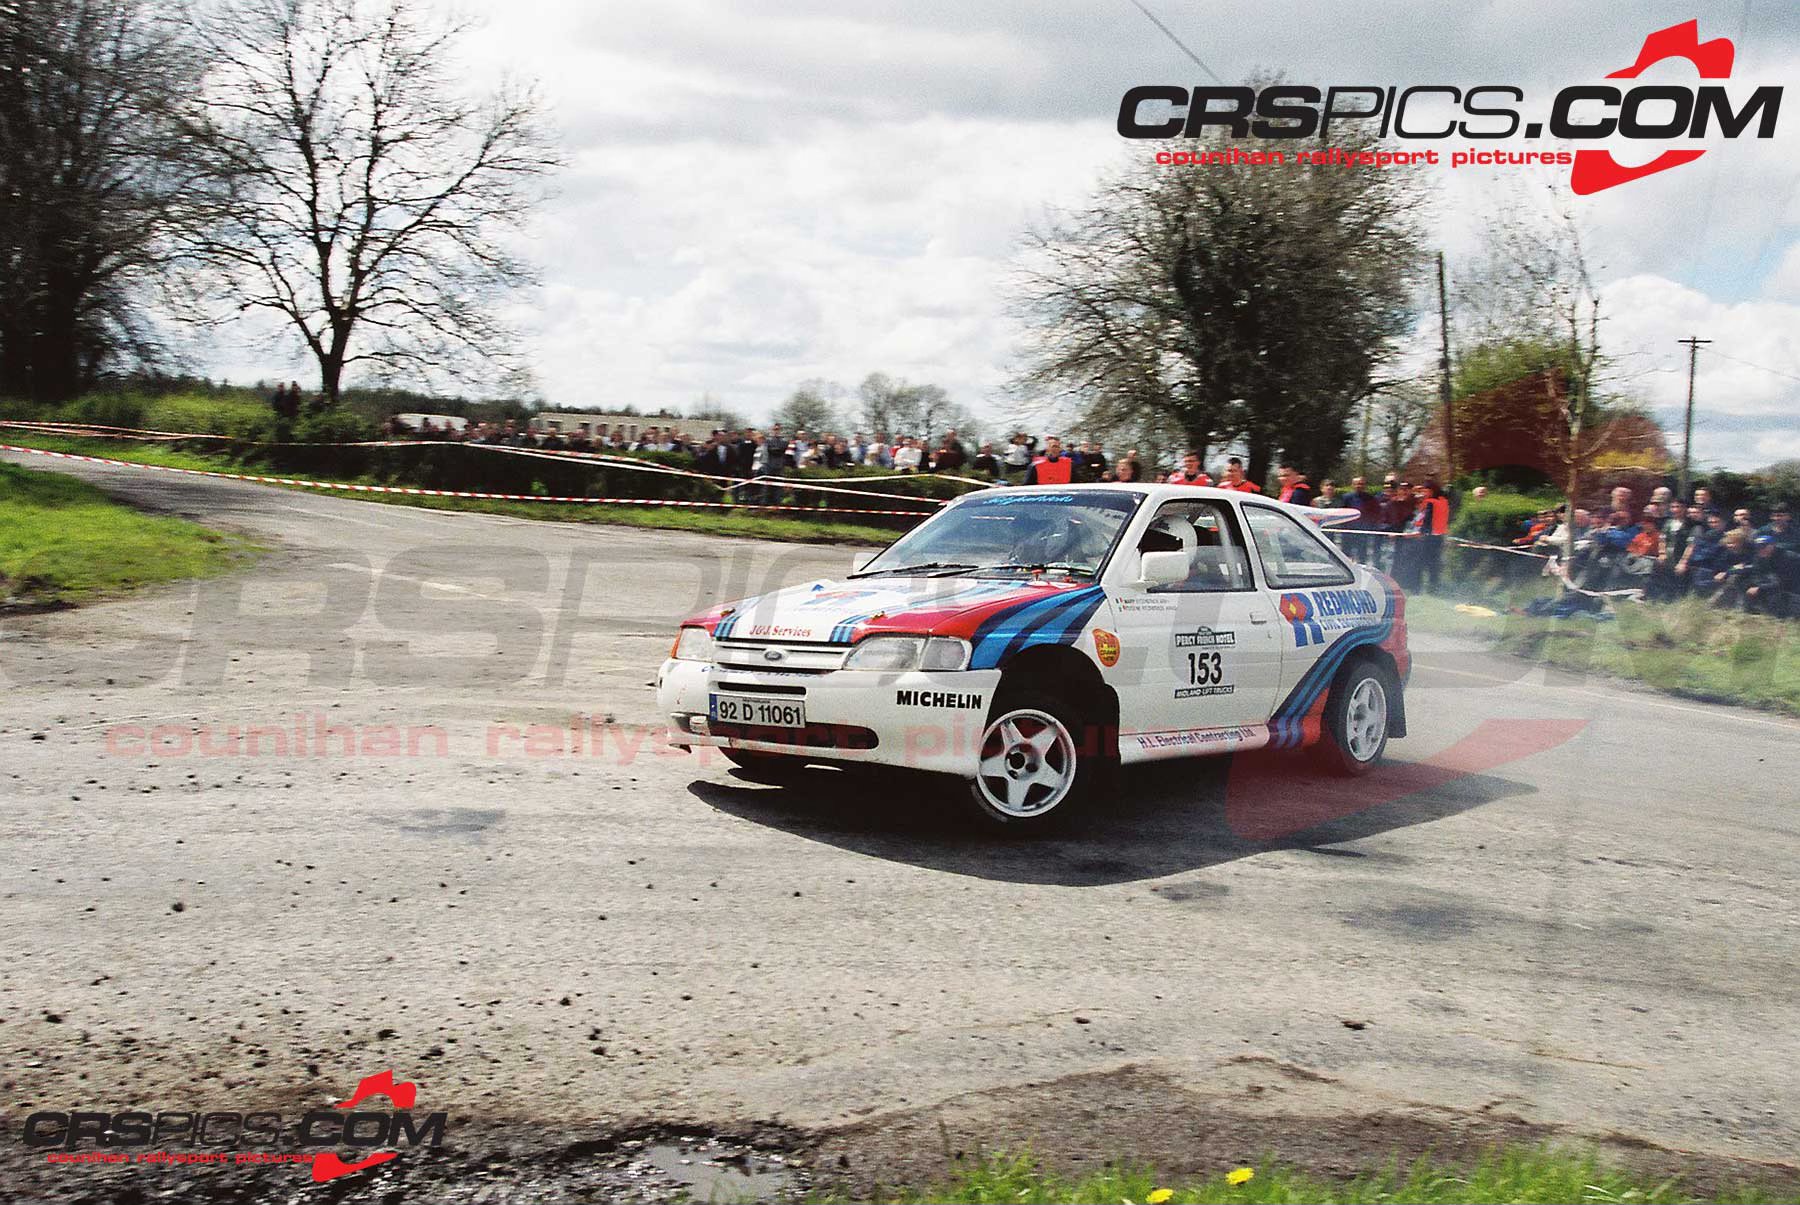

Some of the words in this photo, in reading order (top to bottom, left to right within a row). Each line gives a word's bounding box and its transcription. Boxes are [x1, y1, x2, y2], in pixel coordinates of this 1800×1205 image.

[1311, 590, 1378, 616] REDMOND
[771, 625, 812, 638] Services
[1188, 652, 1223, 685] 153
[896, 691, 982, 709] MICHELIN
[719, 701, 738, 720] 92
[743, 704, 753, 721] D
[758, 705, 801, 725] 11061
[1155, 733, 1198, 747] Electrical
